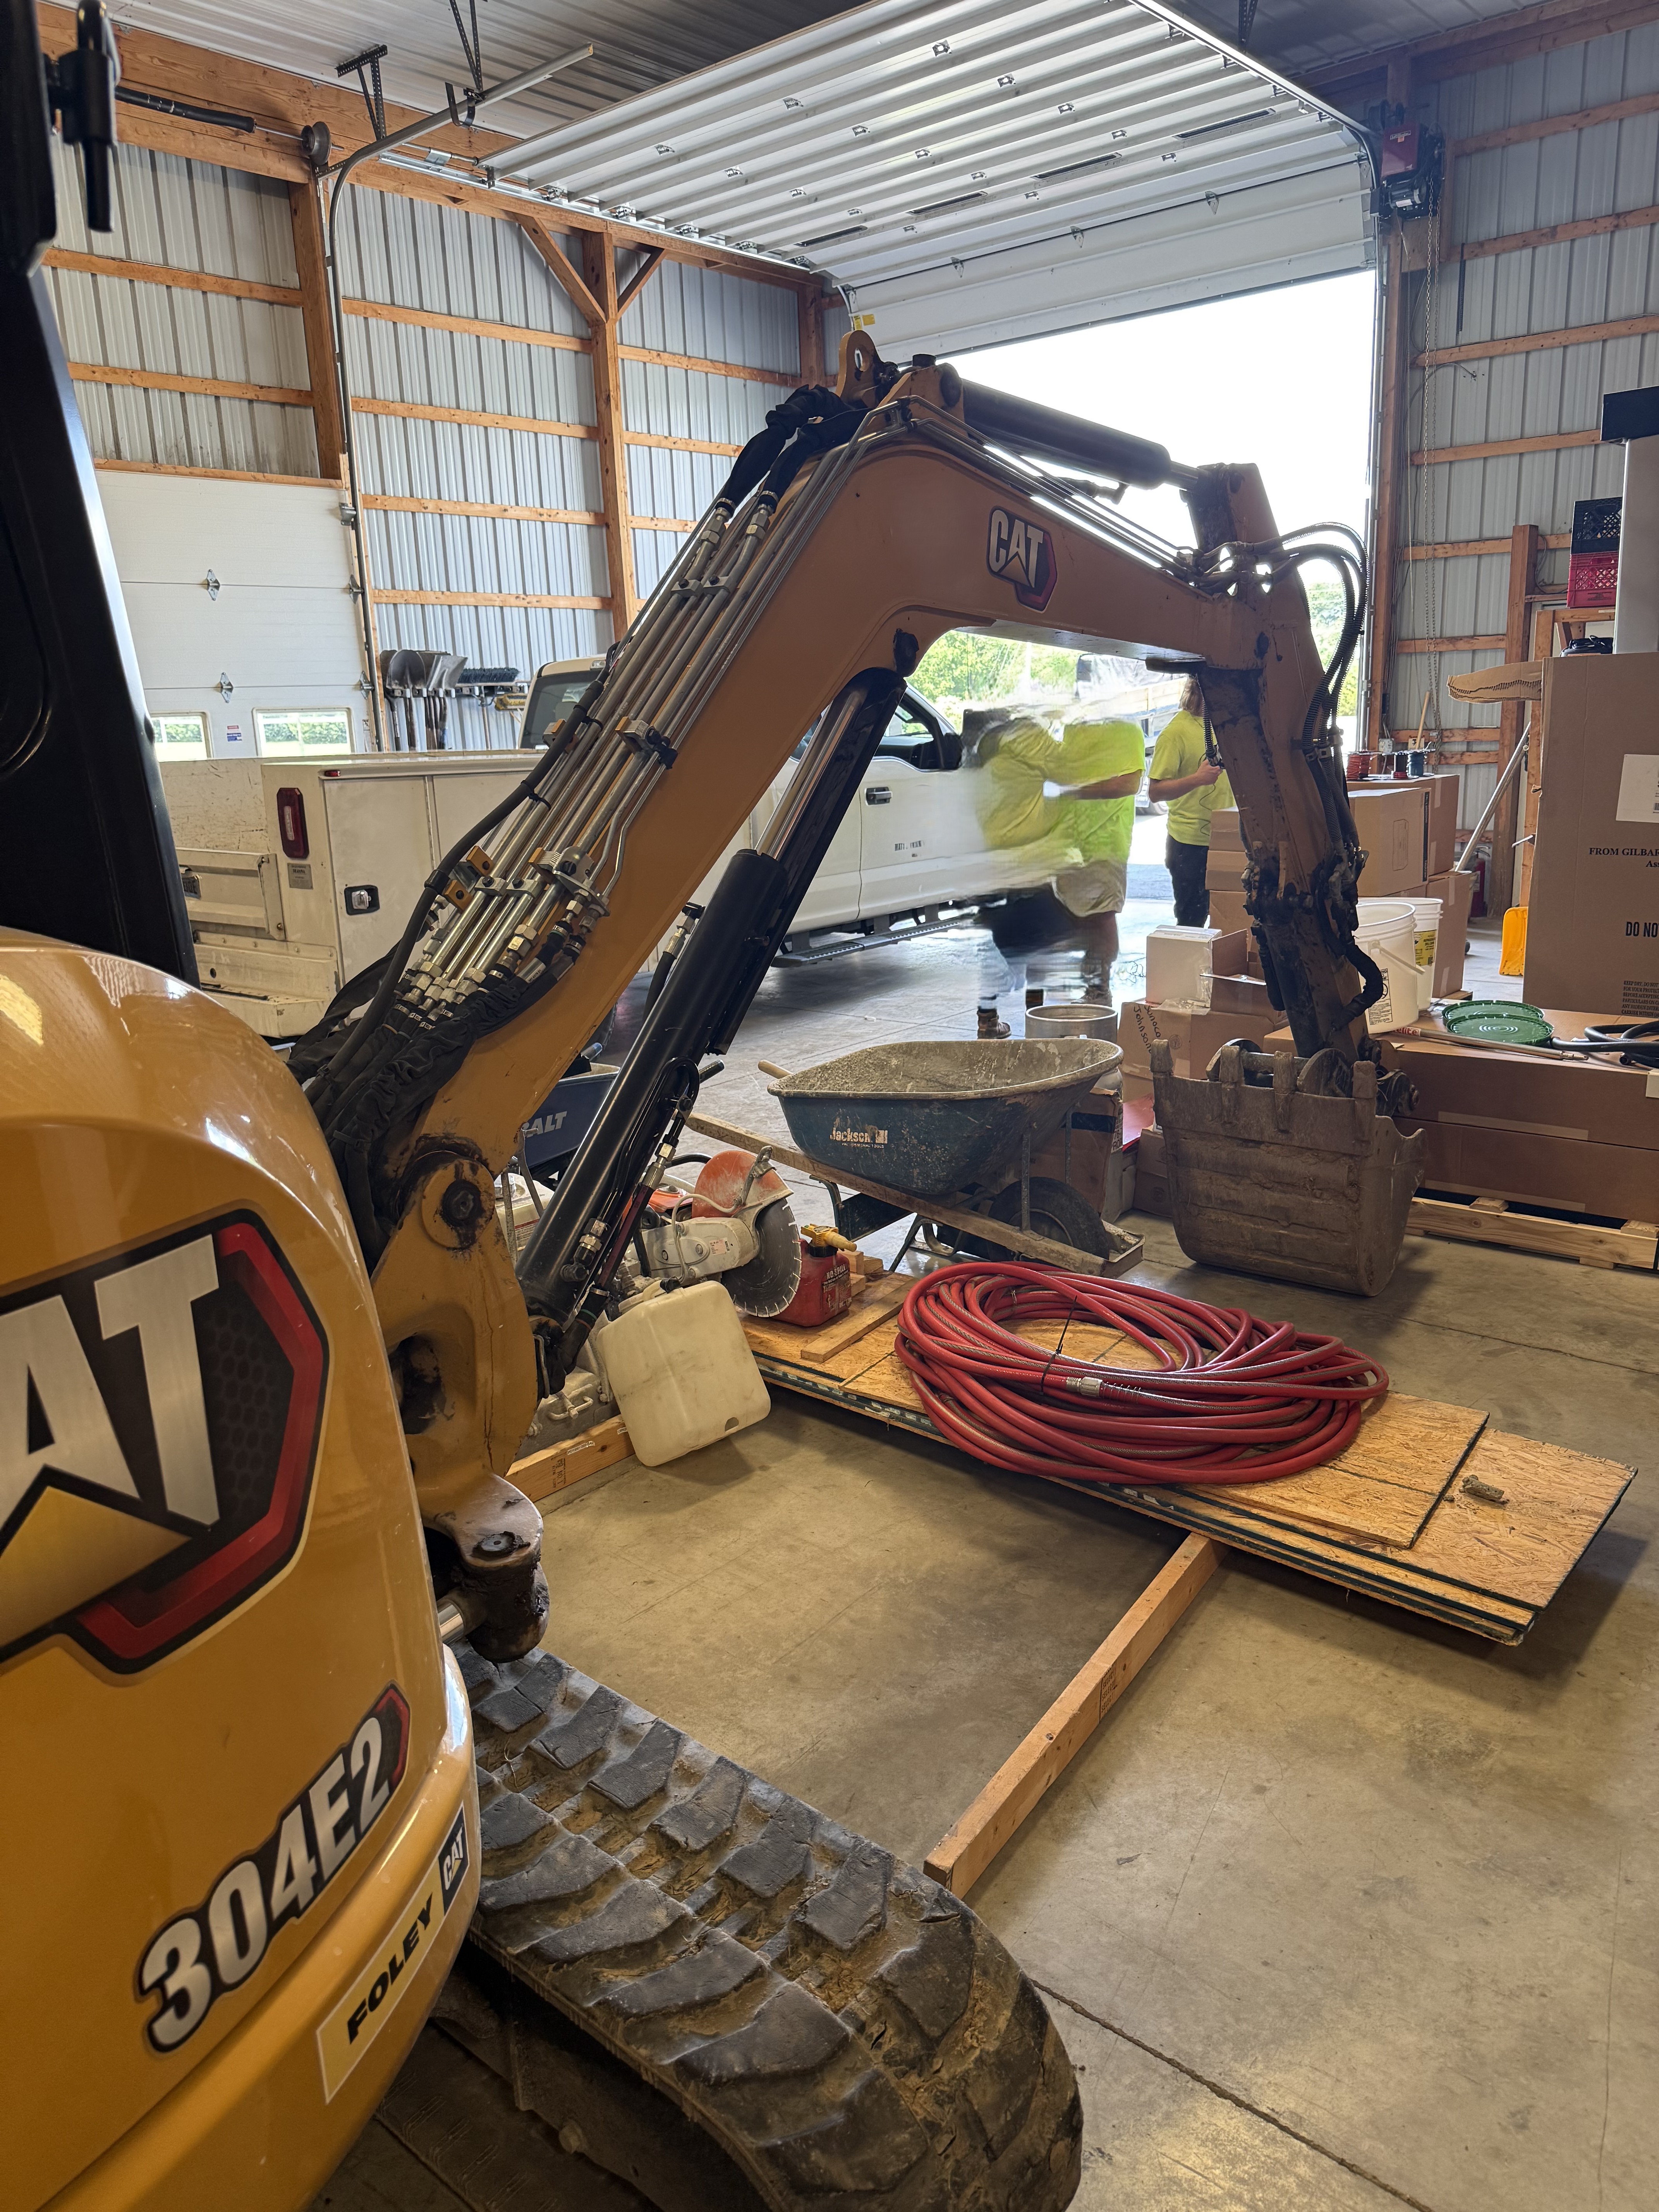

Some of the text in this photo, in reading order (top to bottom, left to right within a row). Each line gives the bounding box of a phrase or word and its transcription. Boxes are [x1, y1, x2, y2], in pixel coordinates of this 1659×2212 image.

[989, 509, 1044, 588] CAT
[1625, 921, 1659, 938] DO NO
[830, 1127, 872, 1143] Jackson
[1102, 1681, 1115, 1701] SELECT
[1101, 1692, 1113, 1713] SELECT
[141, 1716, 390, 2046] 304E2
[347, 1826, 464, 2045] FOLEY CAT
